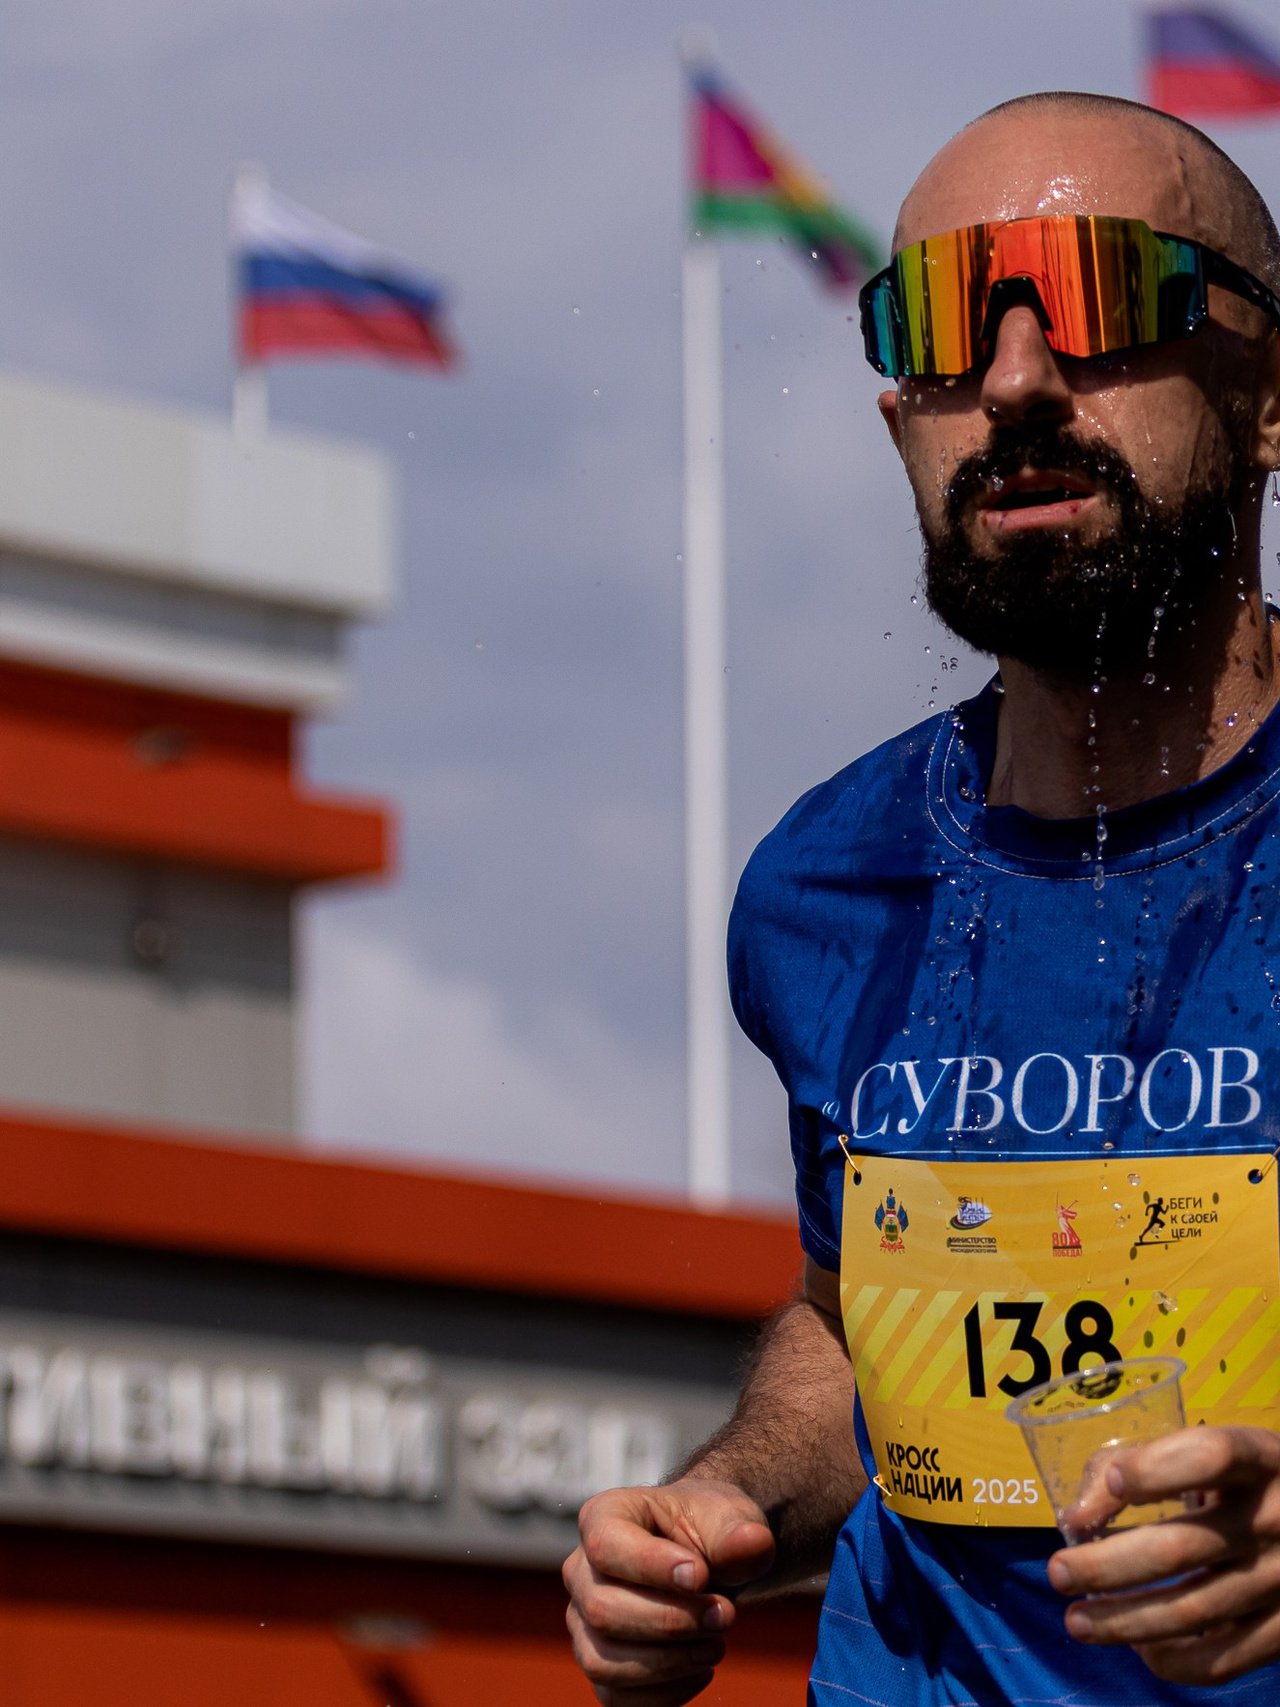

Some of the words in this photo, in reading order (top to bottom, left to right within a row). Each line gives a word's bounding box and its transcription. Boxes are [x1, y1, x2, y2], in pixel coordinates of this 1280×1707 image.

[851, 1046, 1261, 1140] СУВОРОВ
[1169, 1197, 1202, 1210] БЕГИ
[1170, 1214, 1178, 1225] К
[1181, 1210, 1218, 1224] СВОЕЙ
[1052, 1232, 1067, 1247] 80
[1171, 1228, 1202, 1240] ЦЕЛИ
[964, 1299, 1124, 1399] 138
[886, 1441, 941, 1473] КРОСС
[890, 1468, 963, 1504] НАЦИИ
[972, 1478, 1039, 1504] 2025
